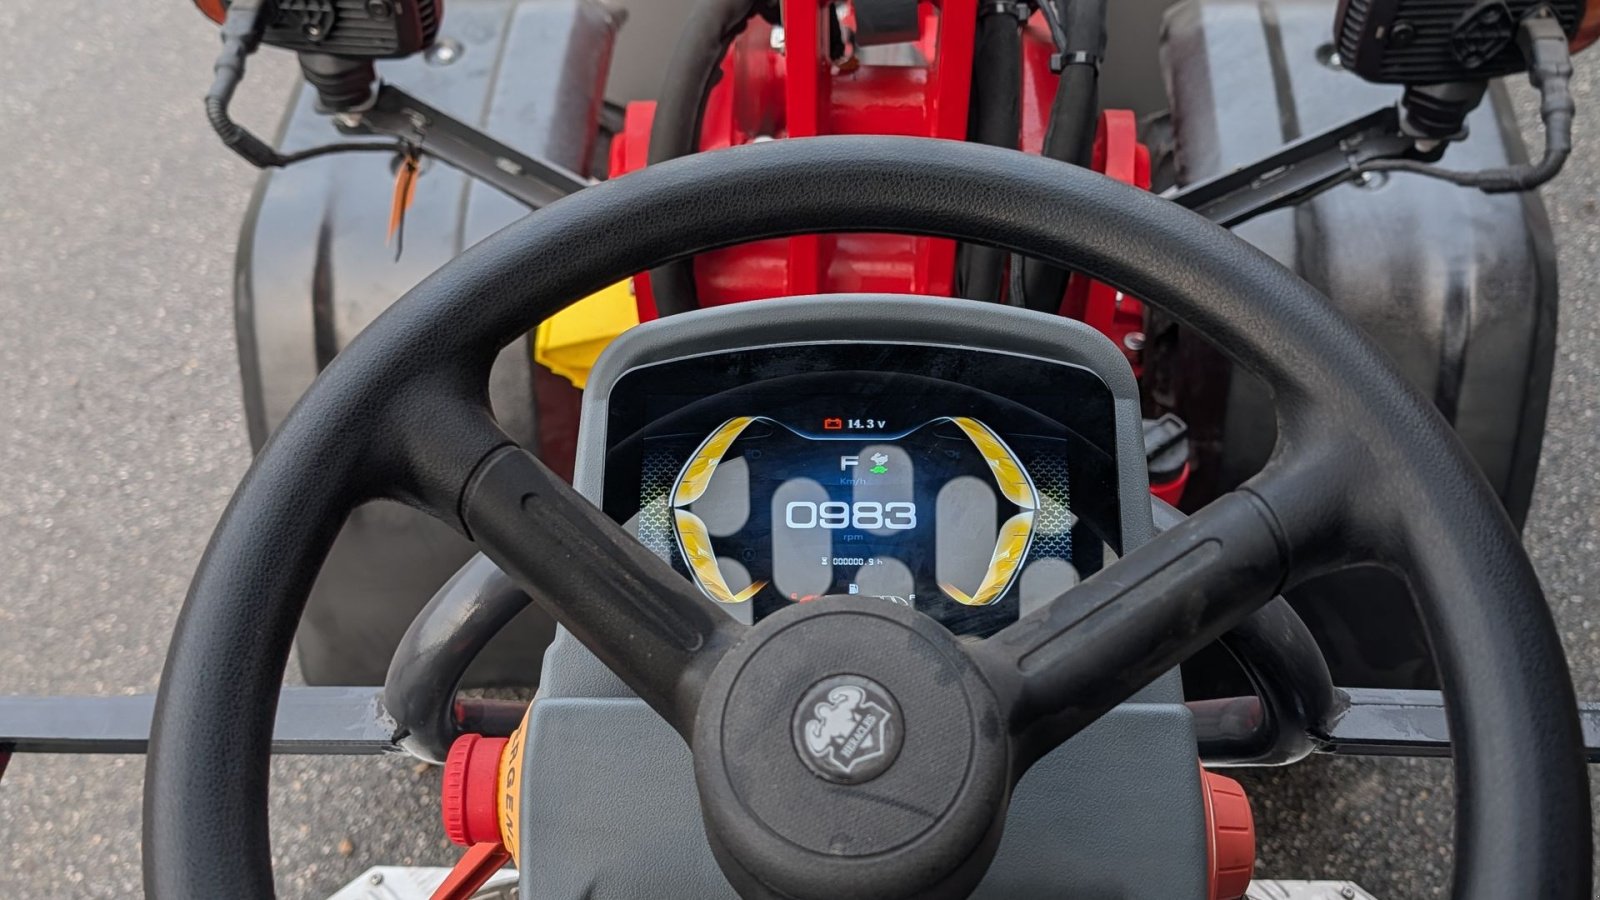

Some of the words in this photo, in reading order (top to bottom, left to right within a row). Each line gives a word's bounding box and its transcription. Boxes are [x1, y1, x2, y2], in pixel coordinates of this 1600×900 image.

[847, 419, 875, 429] 14.3
[841, 455, 860, 471] F
[840, 477, 866, 486] Km/h
[785, 501, 917, 530] 0983
[843, 534, 864, 542] rpm
[832, 558, 874, 566] 000000.9
